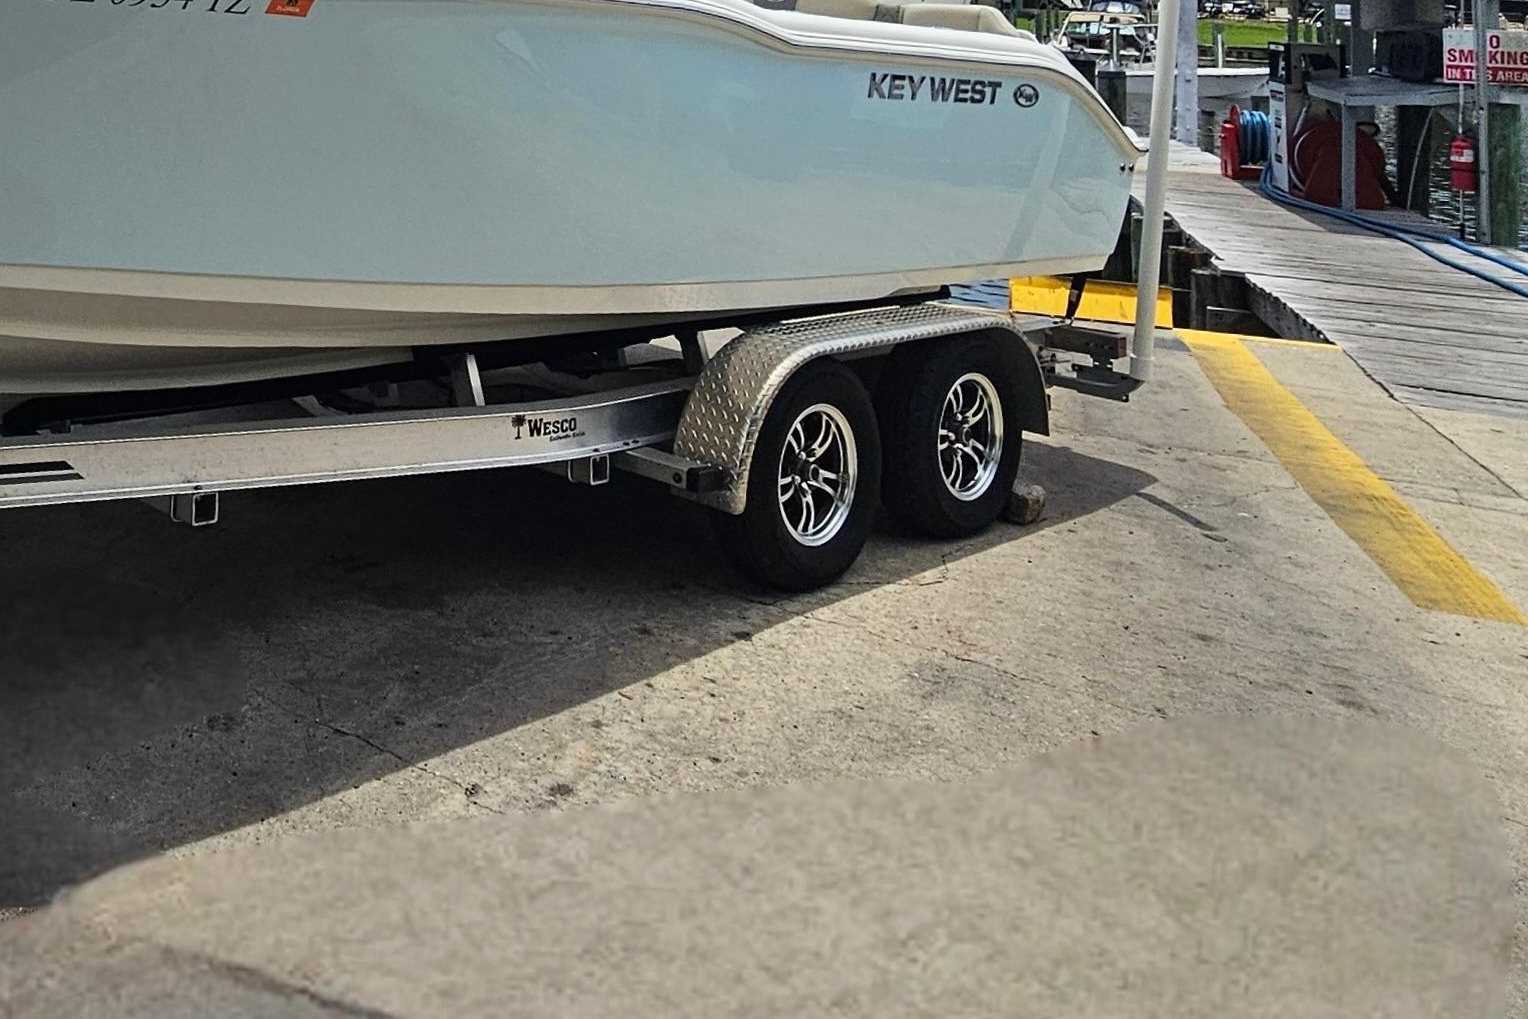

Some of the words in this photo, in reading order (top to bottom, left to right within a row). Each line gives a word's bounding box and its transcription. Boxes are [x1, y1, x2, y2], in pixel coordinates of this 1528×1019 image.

[1447, 48, 1528, 66] SMKING
[1447, 68, 1461, 80] IN
[1496, 70, 1528, 82] AREA
[867, 72, 926, 101] KEY
[929, 76, 1002, 105] WEST
